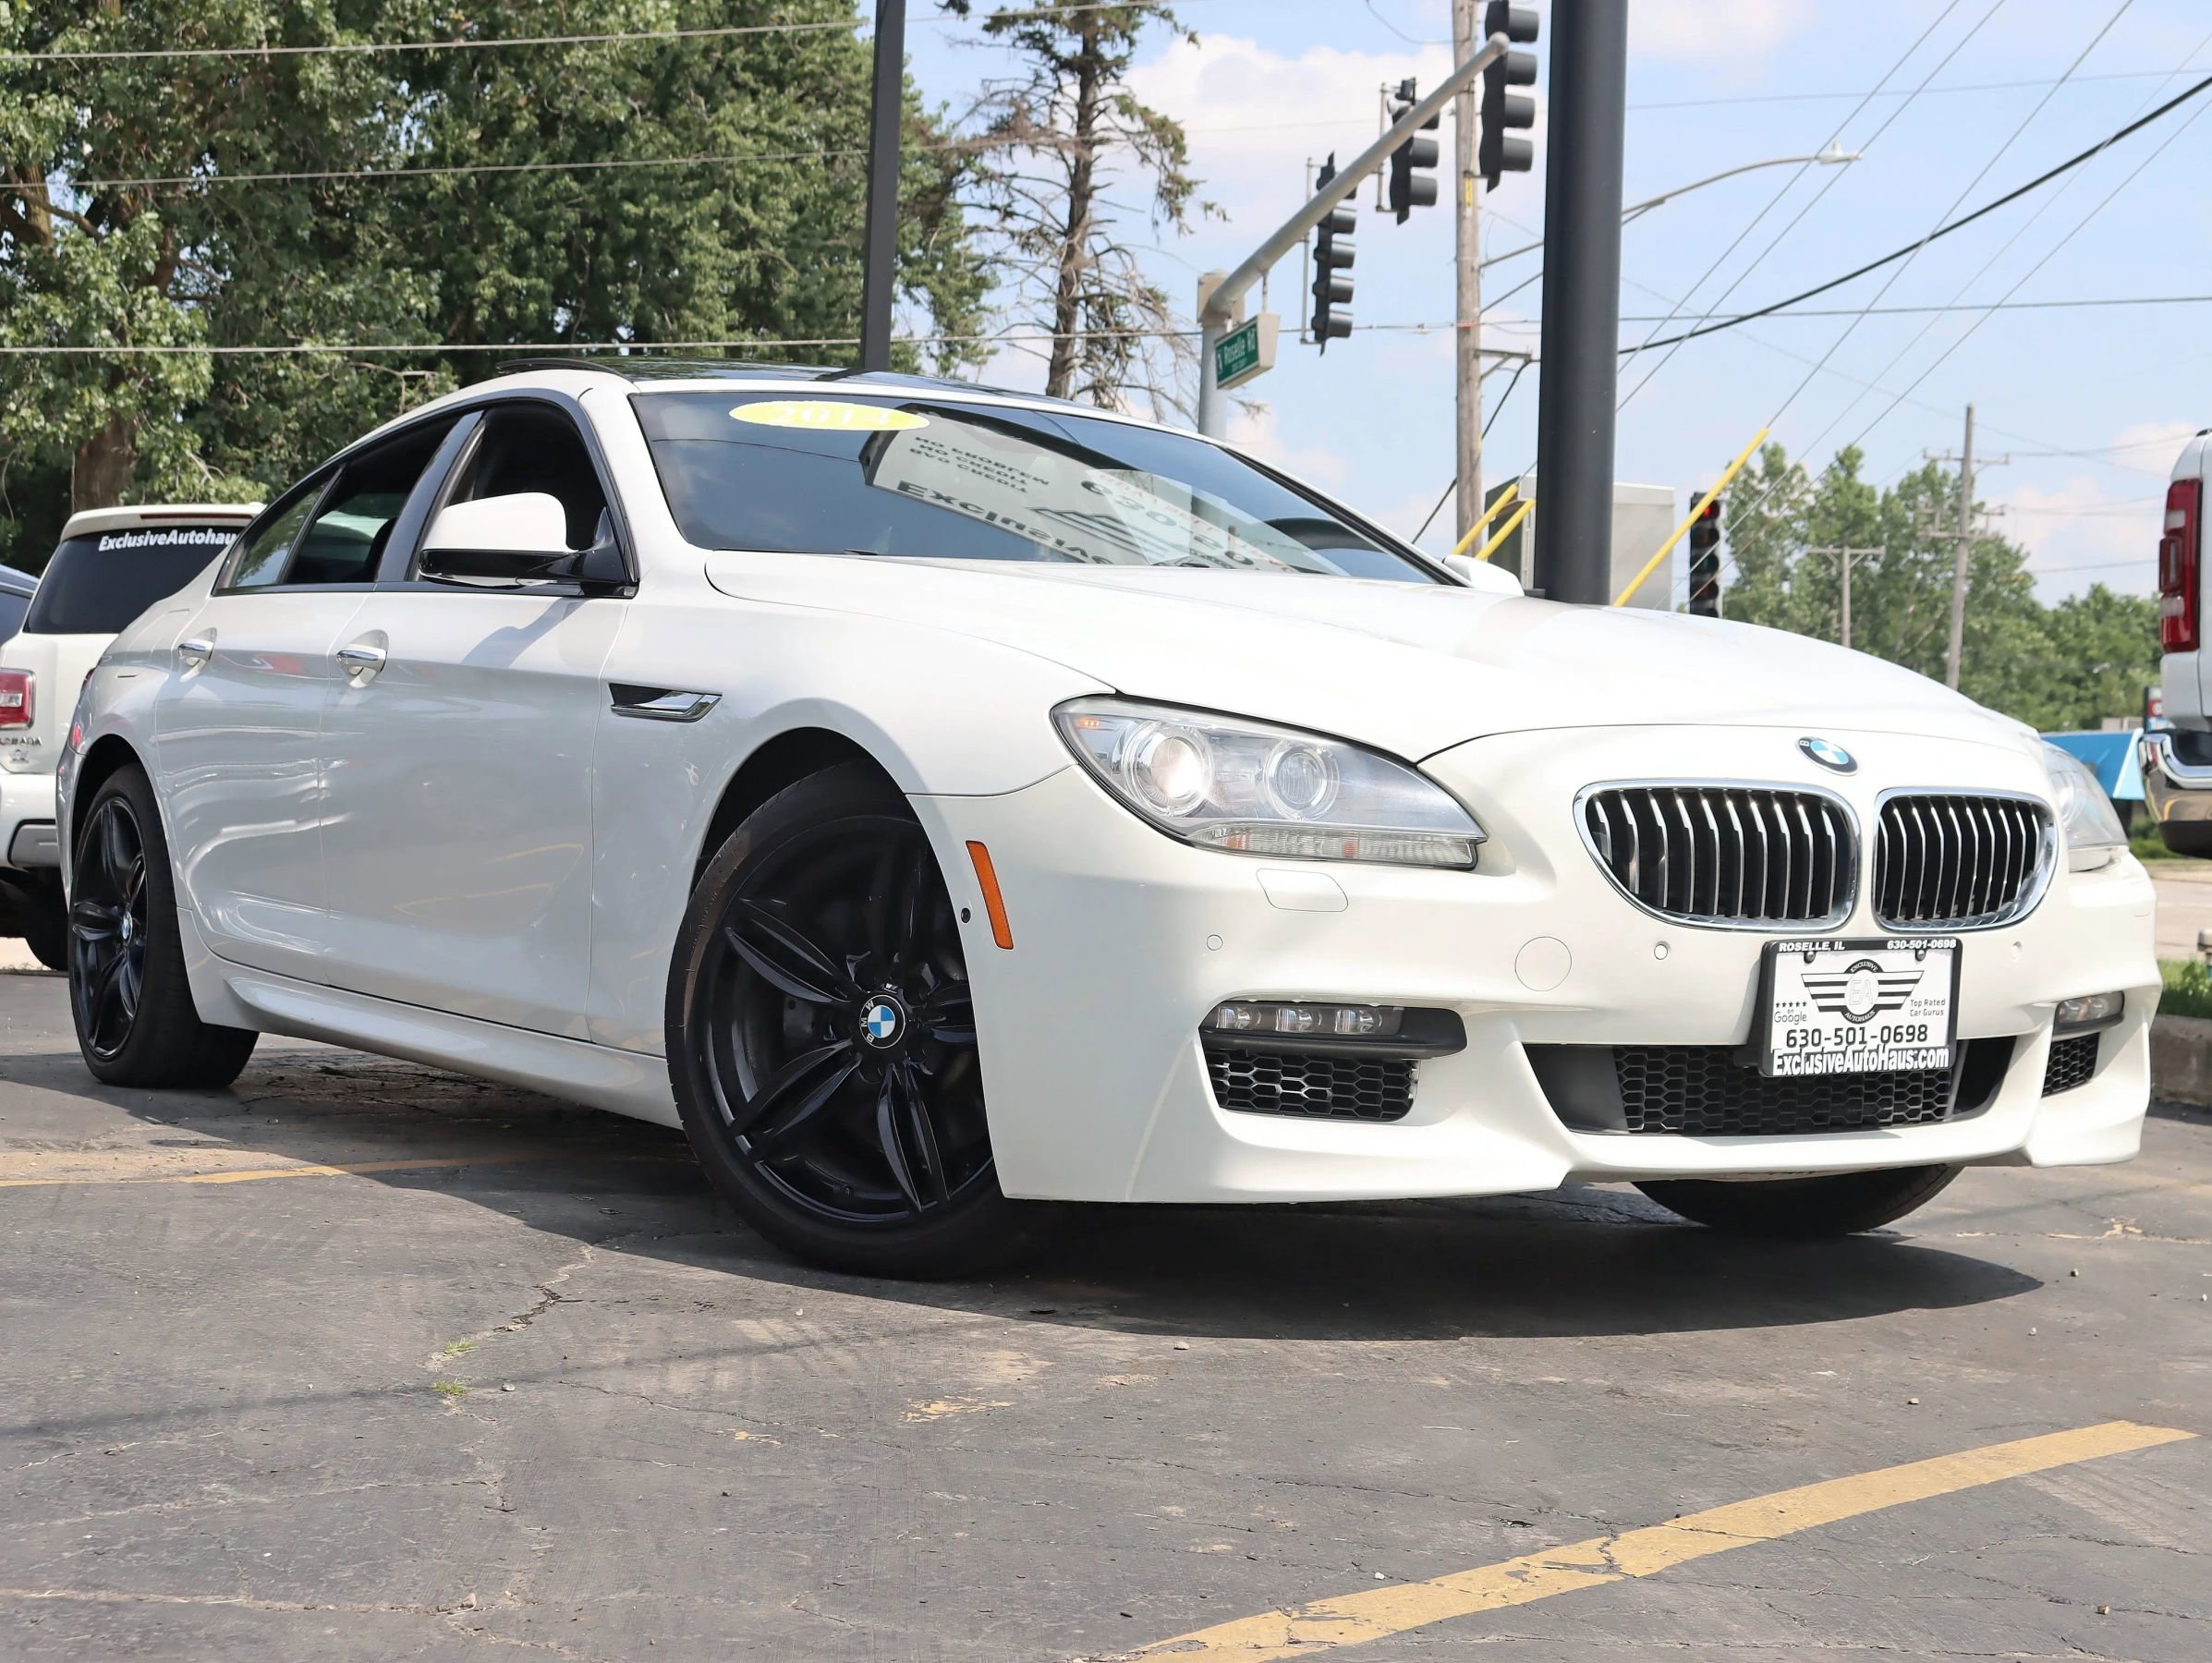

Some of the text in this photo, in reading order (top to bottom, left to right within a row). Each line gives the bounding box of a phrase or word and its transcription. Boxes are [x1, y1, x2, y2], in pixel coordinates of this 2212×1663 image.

[1779, 941, 1845, 953] ROSELLE, IL
[1887, 939, 1957, 950] 630-501-0698
[1910, 998, 1946, 1009] Top Rated
[1773, 1011, 1807, 1026] Google
[1910, 1008, 1945, 1017] Car Gurus
[860, 1000, 875, 1043] BMW
[1786, 1025, 1928, 1048] 630-501-0698
[1772, 1045, 1950, 1075] ExclusiveAutoHaus.com
